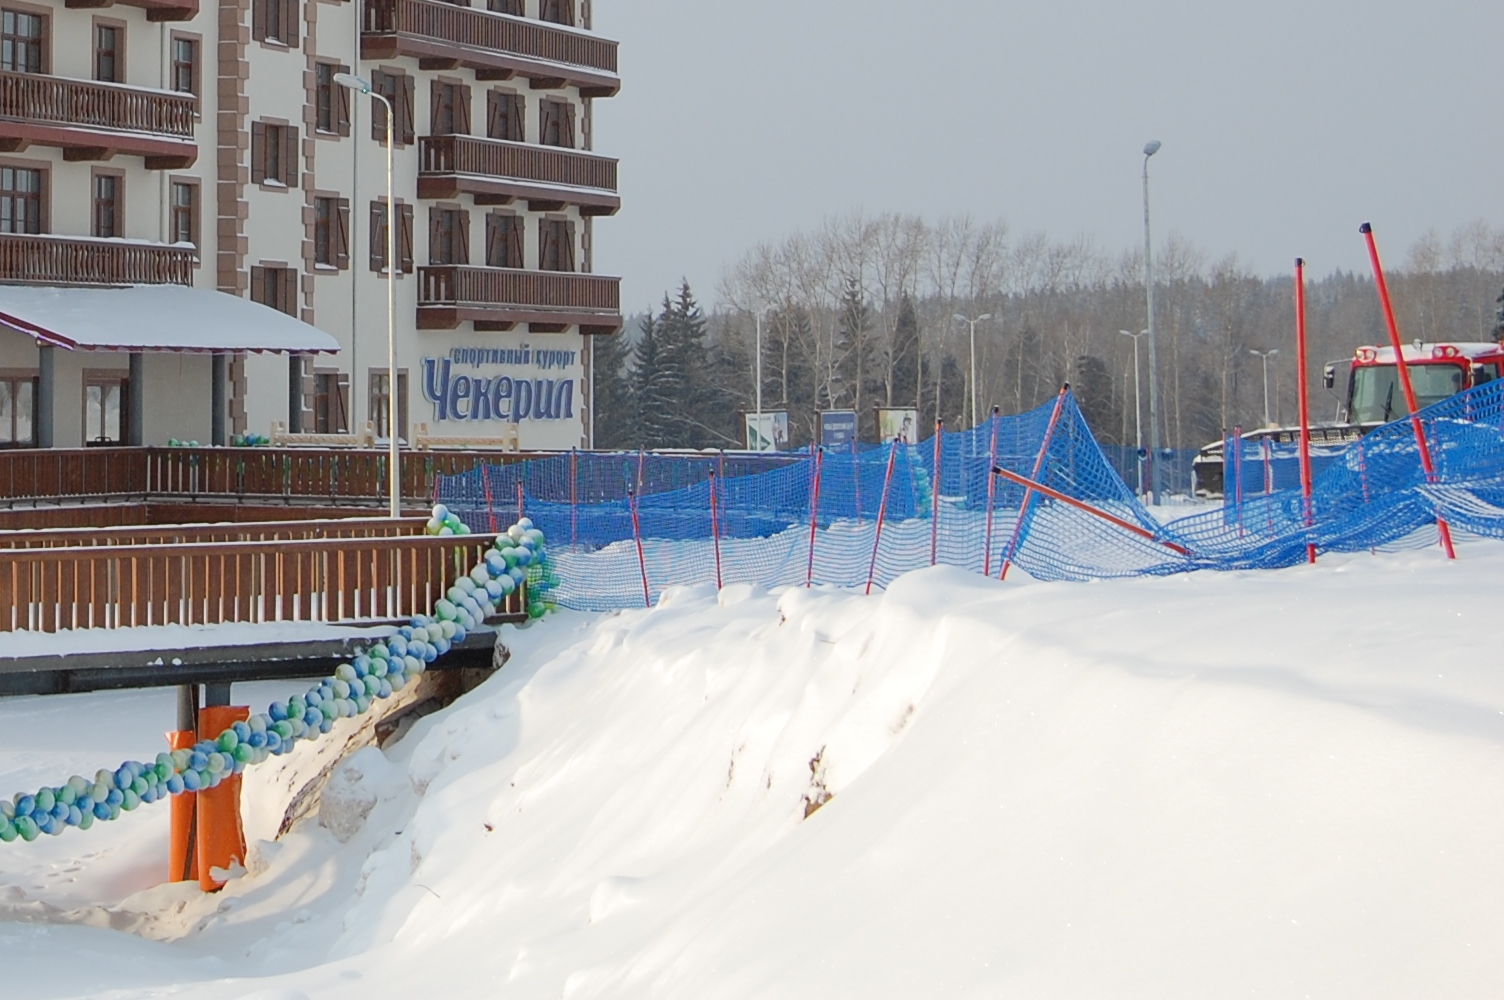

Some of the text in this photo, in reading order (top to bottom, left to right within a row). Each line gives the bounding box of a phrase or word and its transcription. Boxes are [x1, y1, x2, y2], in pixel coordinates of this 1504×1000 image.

[453, 343, 577, 370] спортивный курорт
[423, 357, 574, 424] Чекерил
